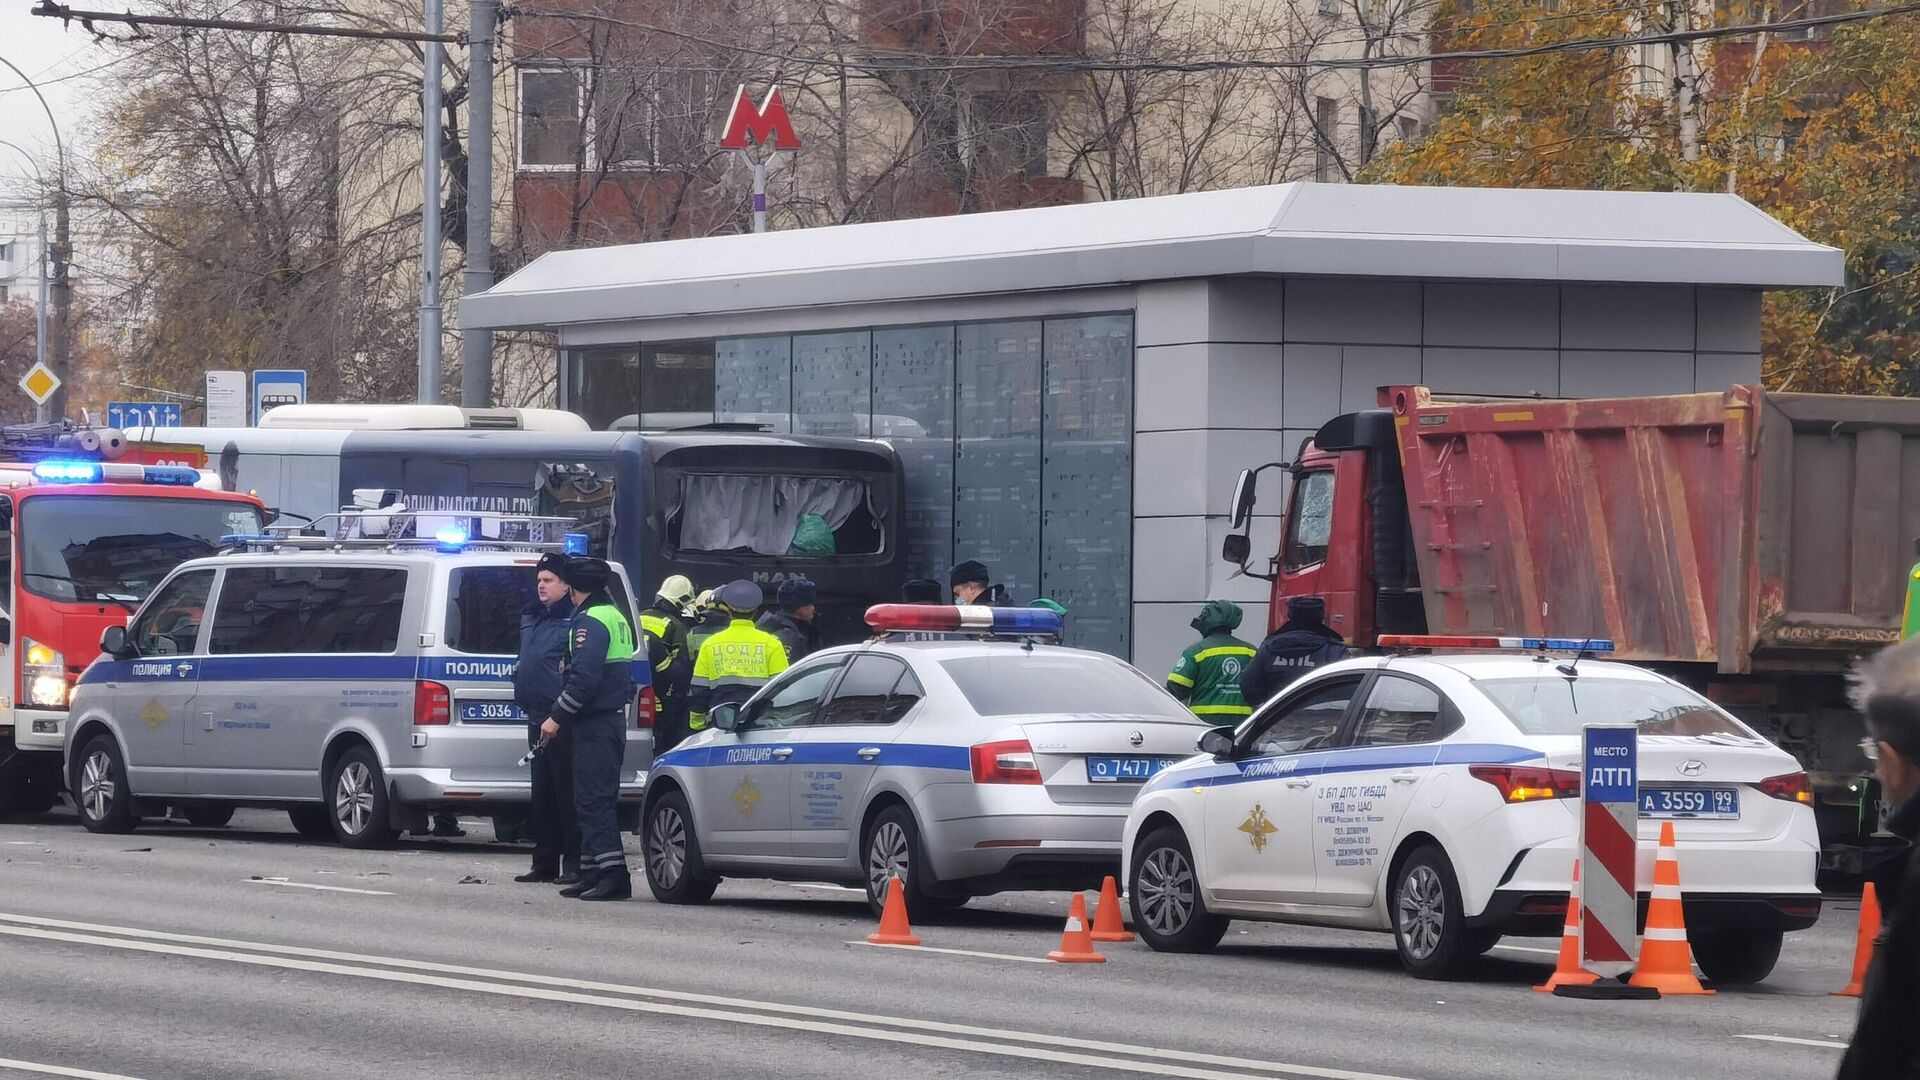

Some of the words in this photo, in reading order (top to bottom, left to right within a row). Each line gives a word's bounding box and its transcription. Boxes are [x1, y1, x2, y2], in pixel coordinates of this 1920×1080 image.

[720, 84, 803, 149] М
[132, 664, 172, 677] ПОЛИЦИЯ
[480, 705, 512, 717] 3036
[726, 748, 772, 763] ПОЛИЦИЯ
[1594, 747, 1628, 757] МЕСТО
[1111, 760, 1150, 776] 7477
[1242, 759, 1299, 778] ПОЛИЦИЯ
[1590, 767, 1632, 787] ДТП
[1339, 786, 1358, 799] ДПС
[1359, 785, 1388, 799] ГИБДД
[1715, 791, 1732, 805] 99
[1331, 802, 1345, 814] УВД
[1661, 791, 1705, 811] 3559
